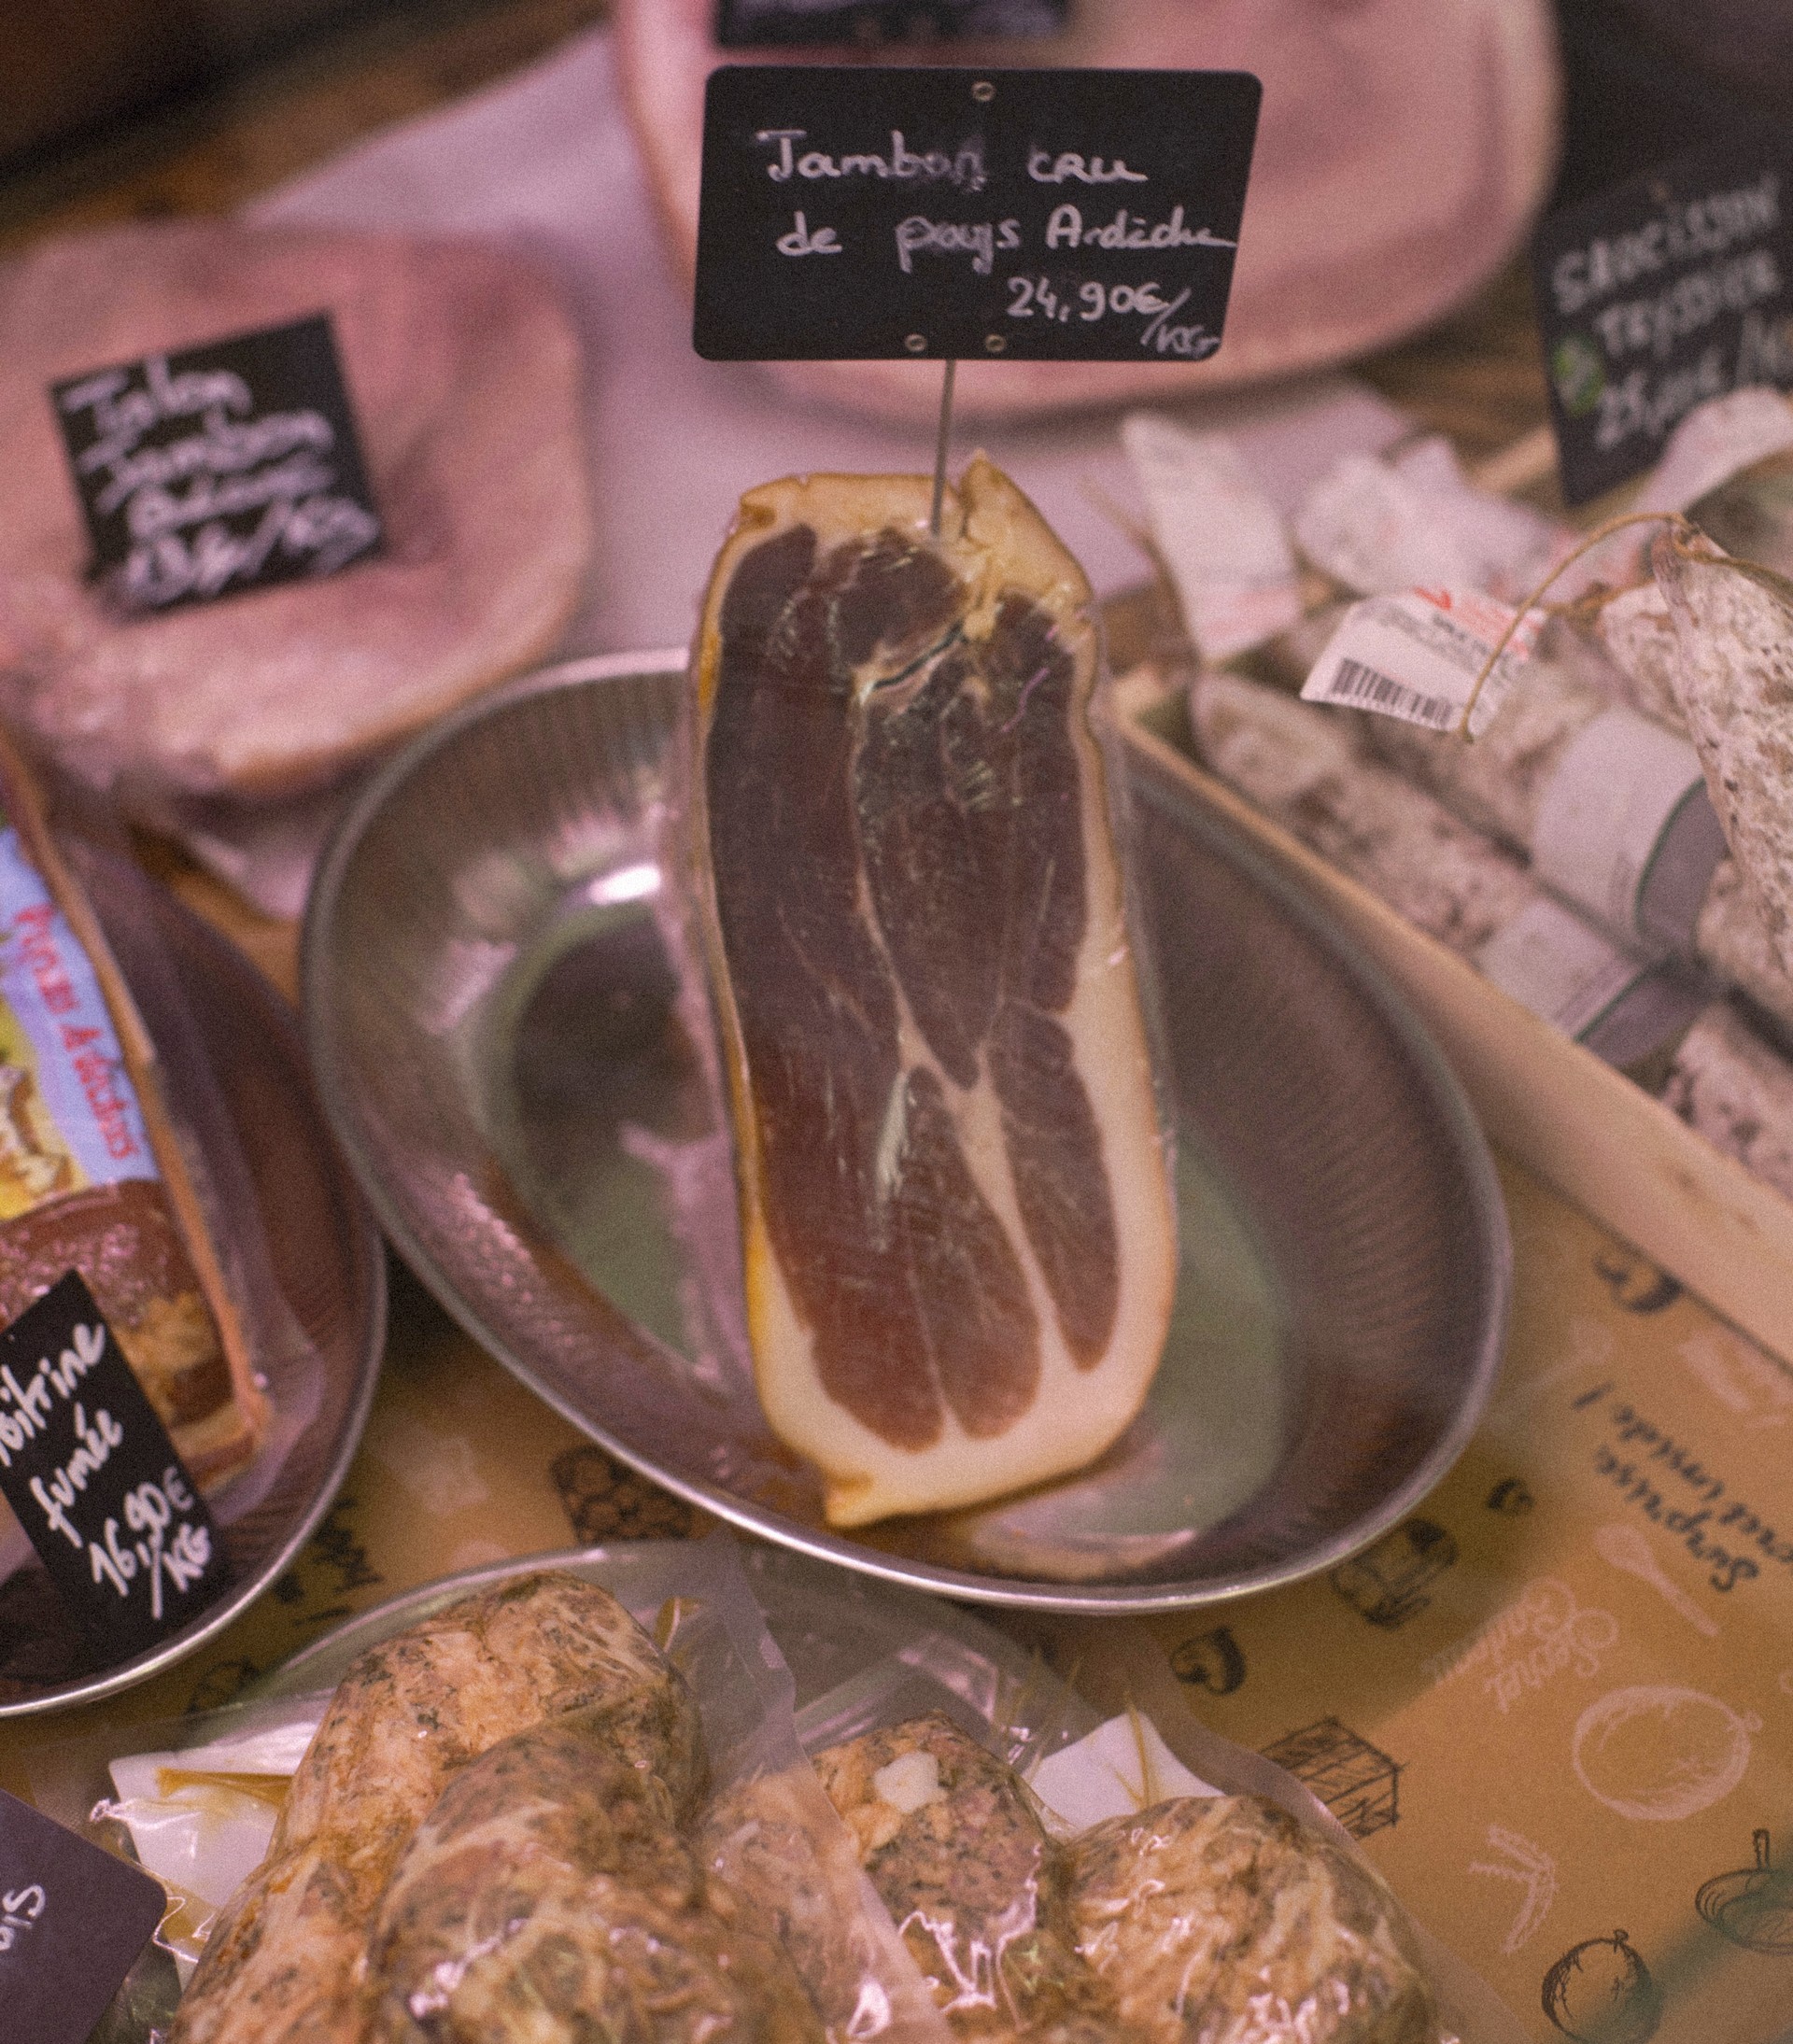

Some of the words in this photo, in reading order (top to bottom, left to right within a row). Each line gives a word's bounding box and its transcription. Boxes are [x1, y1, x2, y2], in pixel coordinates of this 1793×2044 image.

[755, 129, 987, 192] Jambon
[775, 209, 842, 258] de
[895, 215, 1022, 275] pays
[29, 1402, 123, 1549] fumée
